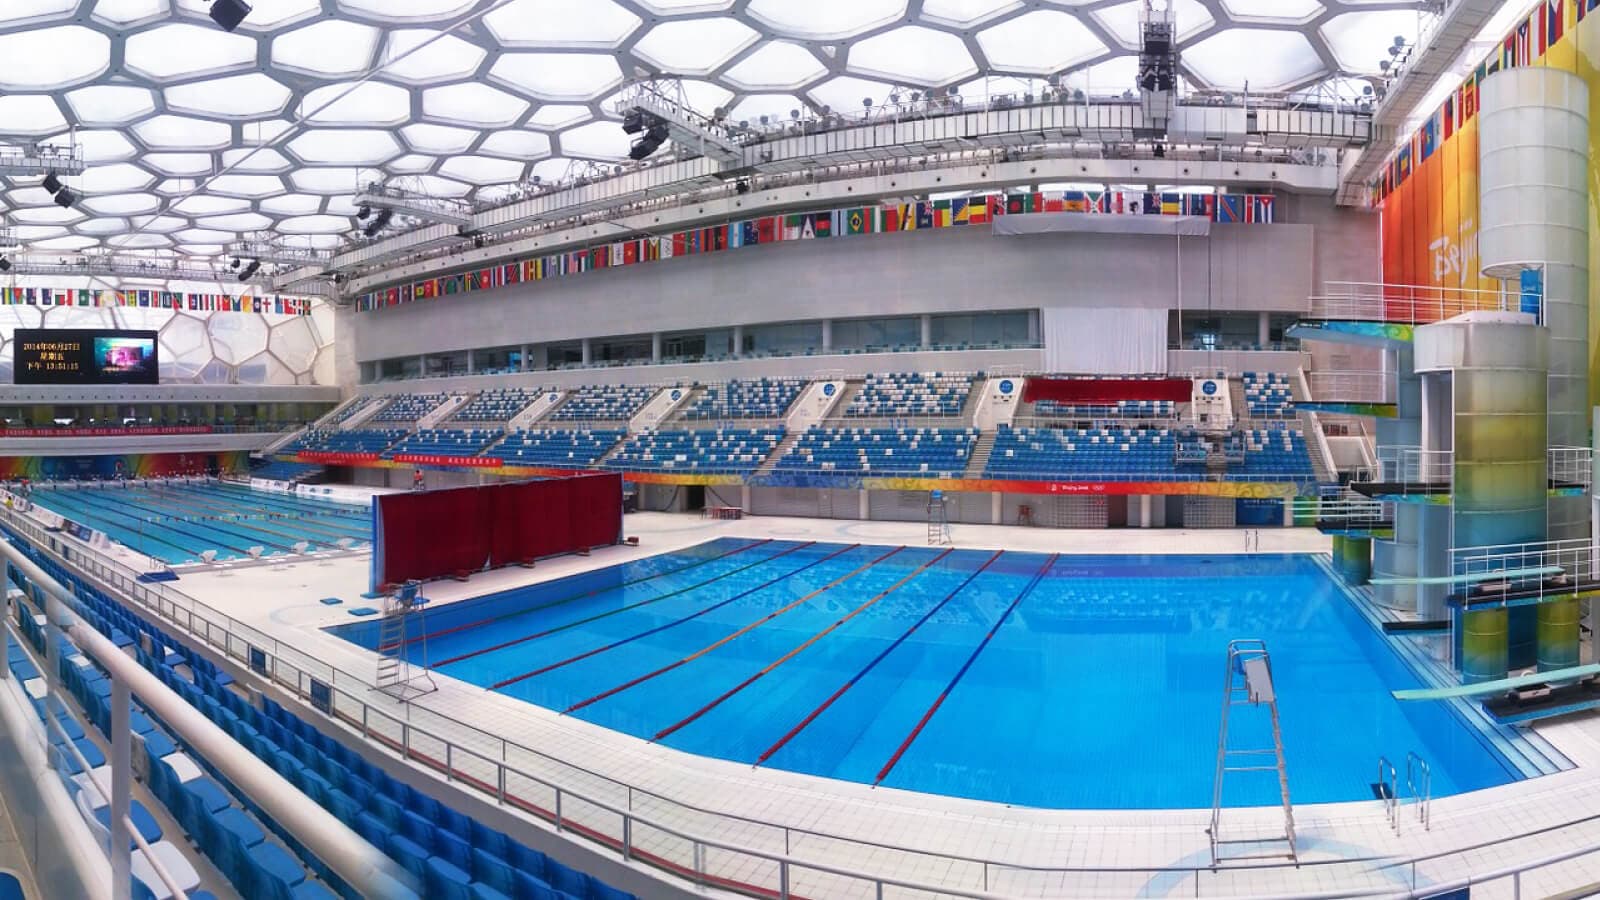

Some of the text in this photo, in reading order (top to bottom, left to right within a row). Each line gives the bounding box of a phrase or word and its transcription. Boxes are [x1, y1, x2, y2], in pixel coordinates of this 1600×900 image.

[40, 351, 64, 360] 星期五
[28, 361, 42, 371] 下午
